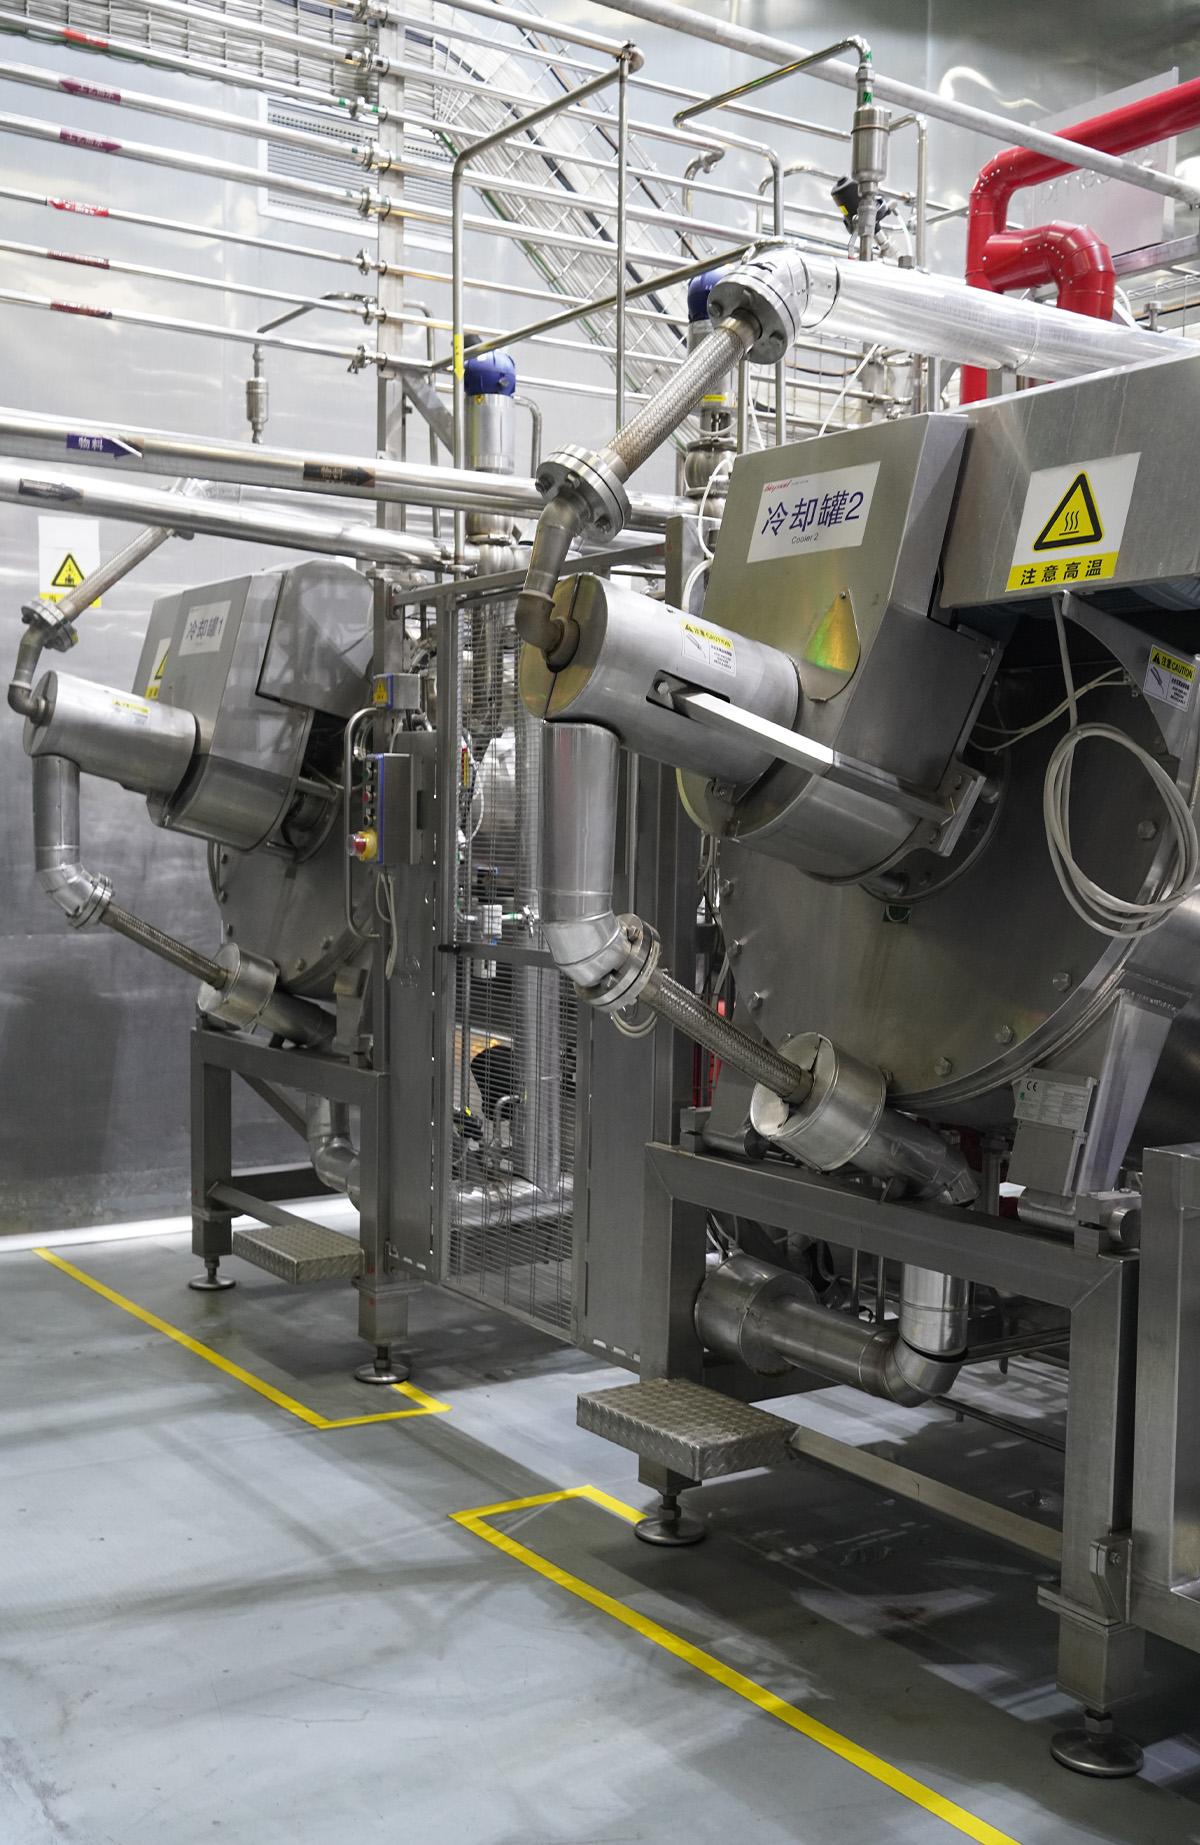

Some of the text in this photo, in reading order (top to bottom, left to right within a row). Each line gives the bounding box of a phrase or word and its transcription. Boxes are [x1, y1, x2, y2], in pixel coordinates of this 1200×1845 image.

[761, 489, 864, 536] 冷却罐2
[814, 533, 819, 541] 2
[1020, 559, 1103, 585] 注意高温
